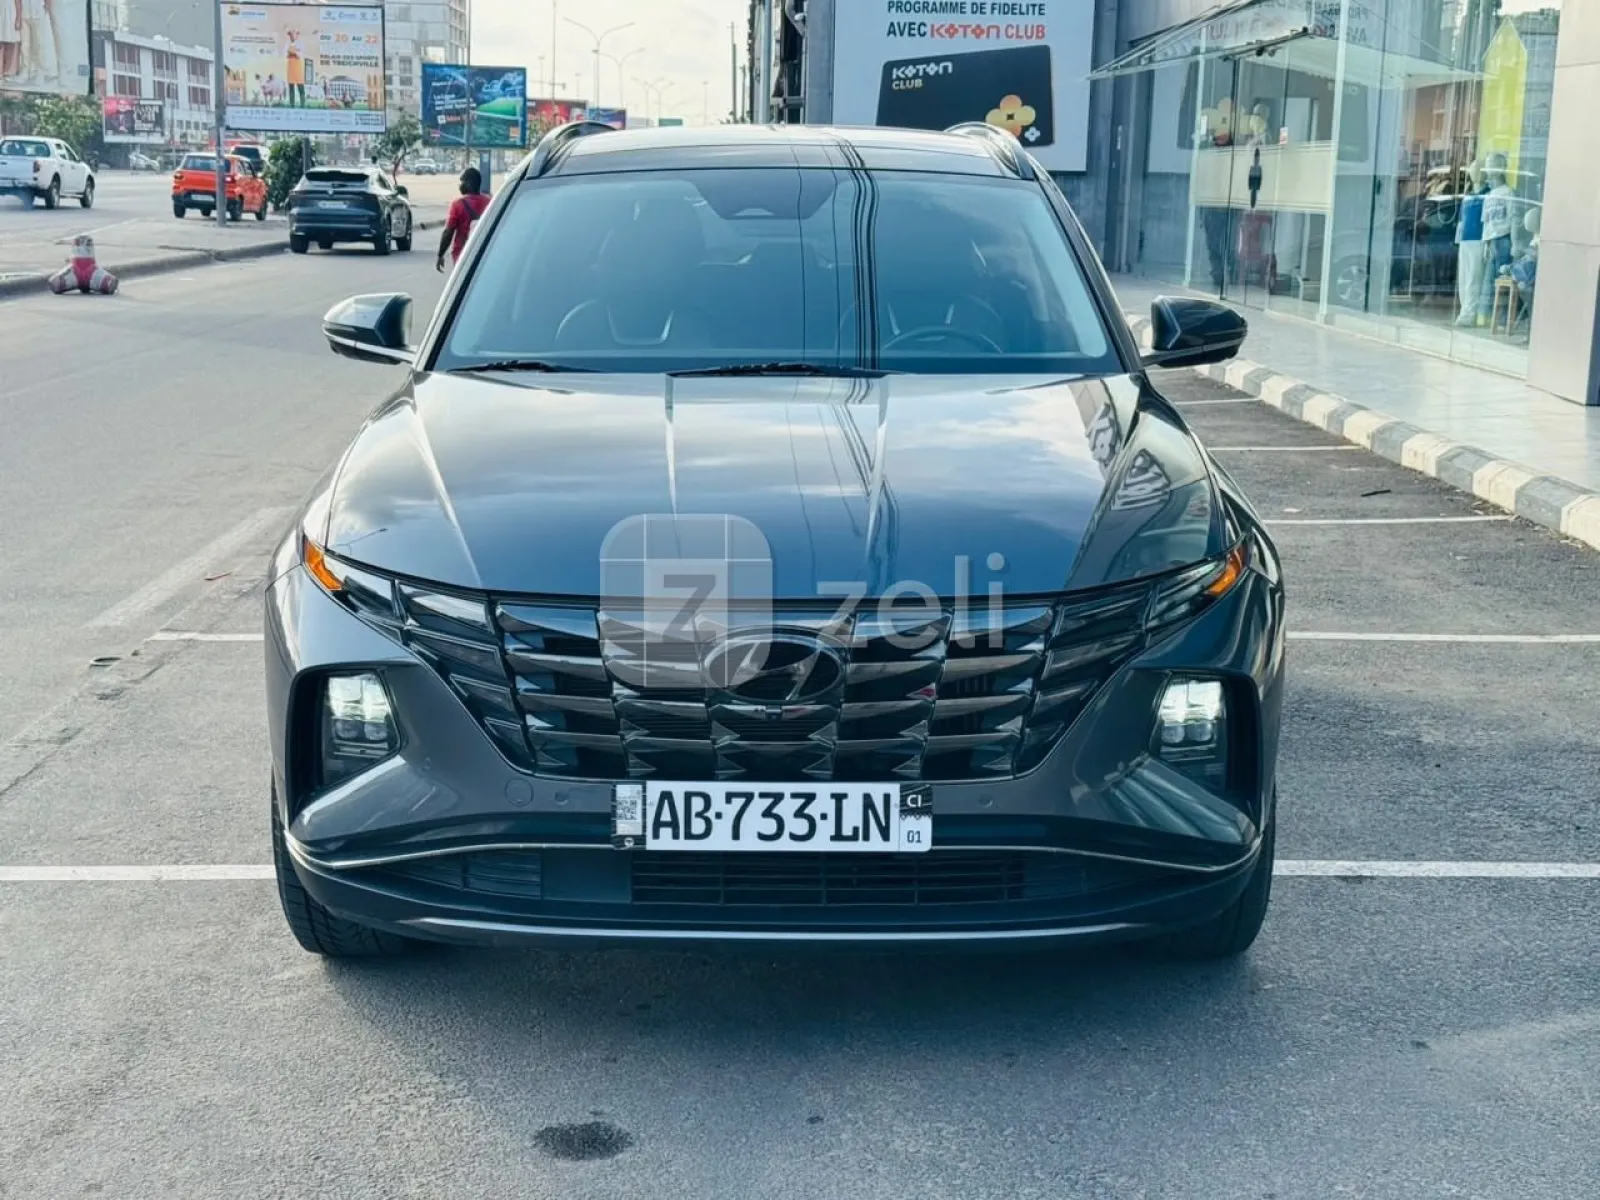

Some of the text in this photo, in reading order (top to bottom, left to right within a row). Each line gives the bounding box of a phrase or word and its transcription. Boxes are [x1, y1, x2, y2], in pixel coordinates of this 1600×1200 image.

[887, 0, 1046, 16] PROGRAMME DE FIDELITE
[886, 22, 1046, 40] AVEC KOTON CLUB
[892, 61, 953, 80] KOTON
[892, 78, 923, 90] CLUB
[906, 794, 922, 807] CI
[906, 829, 922, 844] 01
